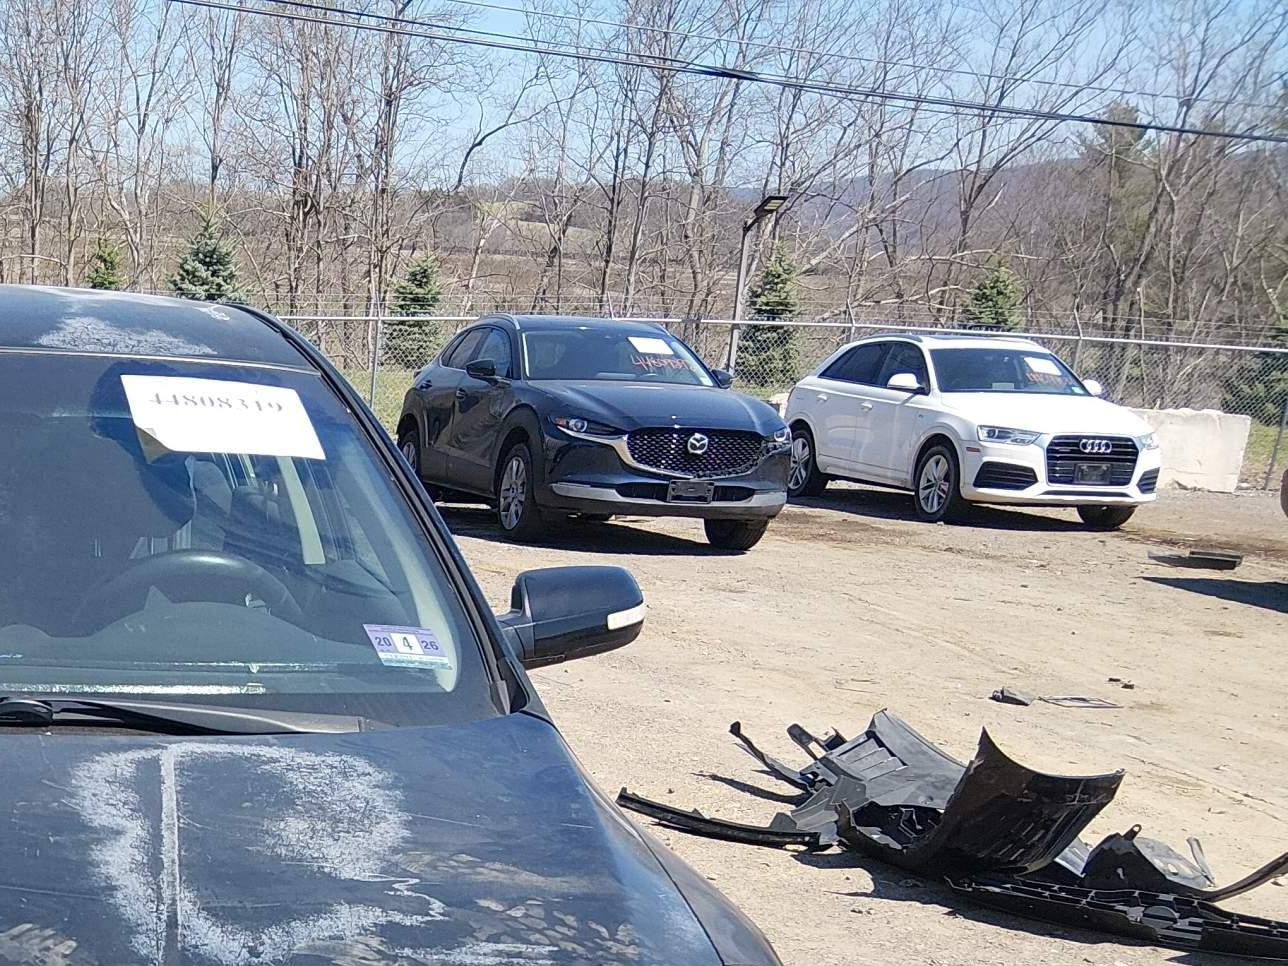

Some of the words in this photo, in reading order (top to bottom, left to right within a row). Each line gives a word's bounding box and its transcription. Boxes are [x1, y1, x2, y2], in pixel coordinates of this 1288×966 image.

[375, 636, 392, 647] 20
[402, 636, 414, 651] 4
[421, 640, 439, 651] 26
